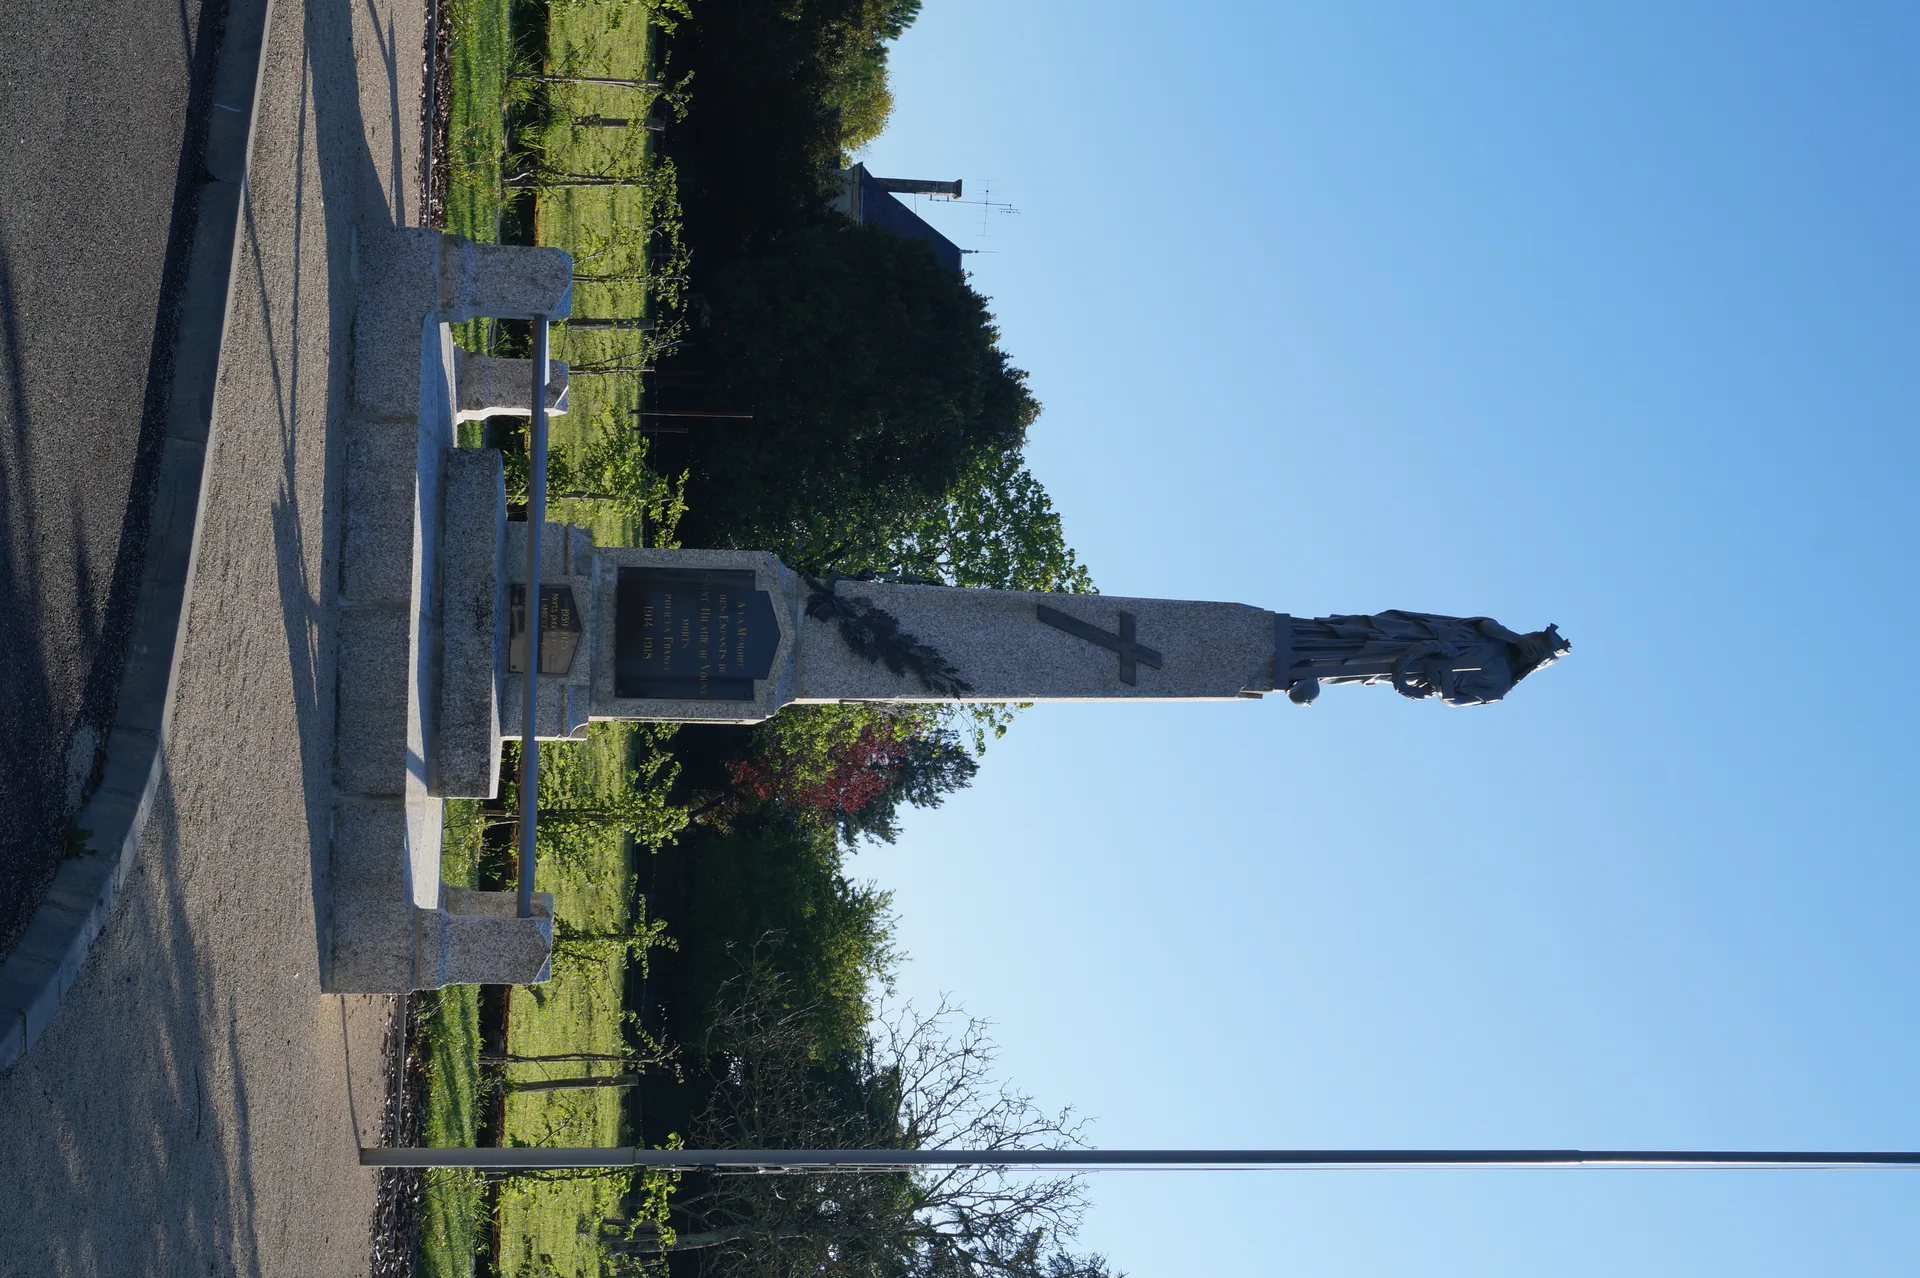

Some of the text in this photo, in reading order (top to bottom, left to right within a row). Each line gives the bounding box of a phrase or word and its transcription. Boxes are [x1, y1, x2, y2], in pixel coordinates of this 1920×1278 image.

[700, 573, 711, 602] SAINT
[663, 593, 672, 618] POUR
[643, 606, 654, 660] 1914 1918
[681, 618, 690, 649] MORTS
[718, 594, 729, 675] DES ENFANTS DE
[663, 636, 674, 671] FRANCE
